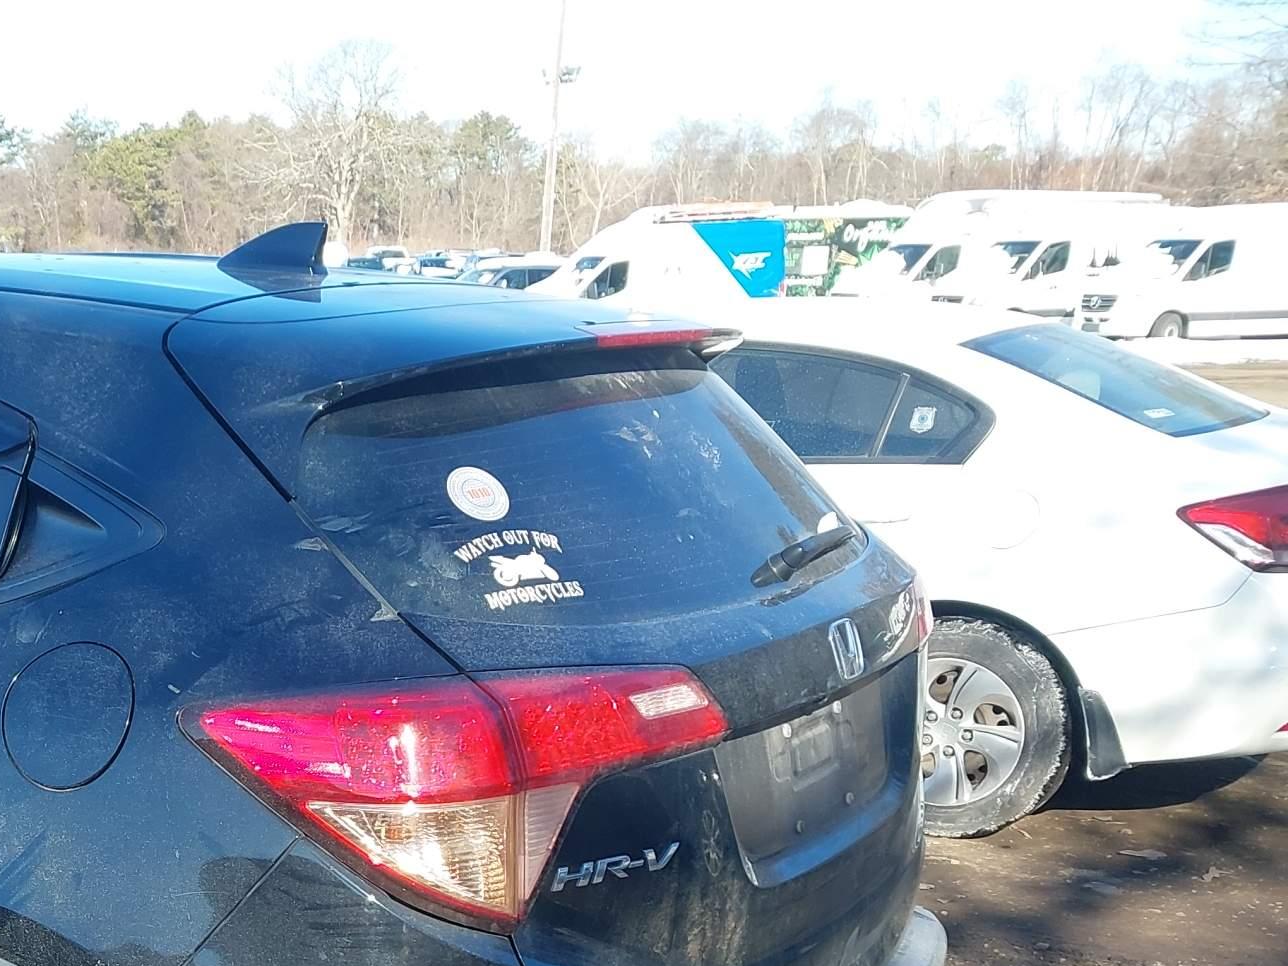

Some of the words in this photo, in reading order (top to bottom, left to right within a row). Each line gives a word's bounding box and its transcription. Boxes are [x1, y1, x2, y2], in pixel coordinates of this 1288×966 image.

[453, 532, 504, 563] WATCH
[502, 529, 530, 545] OUT
[530, 530, 563, 554] FOR
[484, 580, 584, 611] MOTORCYCLES
[550, 841, 681, 893] HR-V
